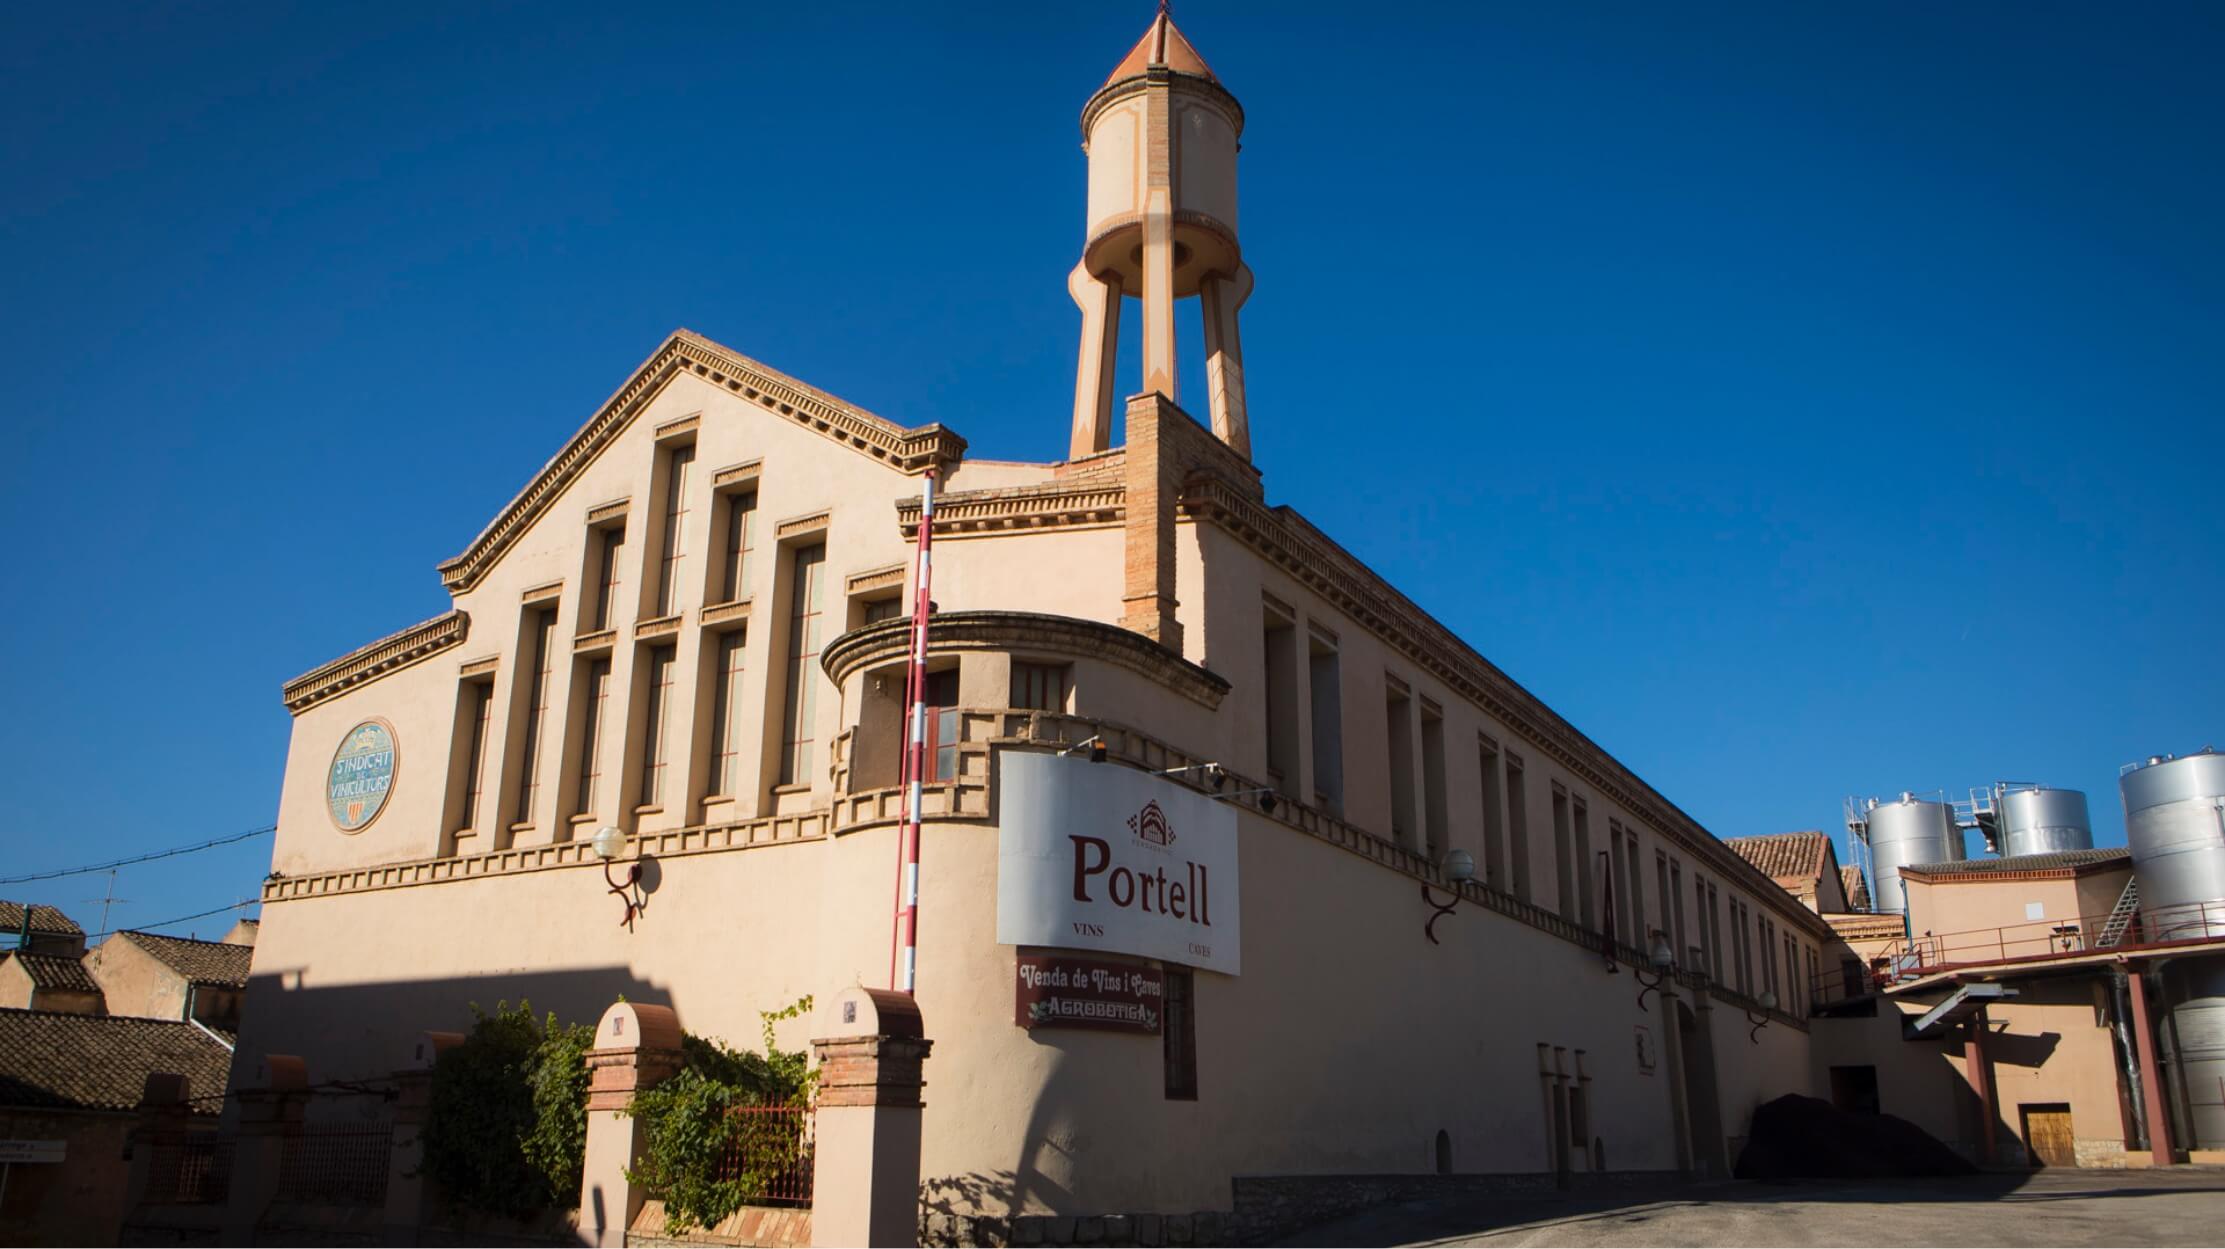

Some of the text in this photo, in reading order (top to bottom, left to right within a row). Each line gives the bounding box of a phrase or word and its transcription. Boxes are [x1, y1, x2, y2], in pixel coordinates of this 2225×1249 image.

[336, 751, 388, 774] SINDICAT
[1068, 834, 1211, 927] Portell
[1073, 923, 1104, 938] VINS
[1020, 964, 1161, 998] Venda de Vins i Caves
